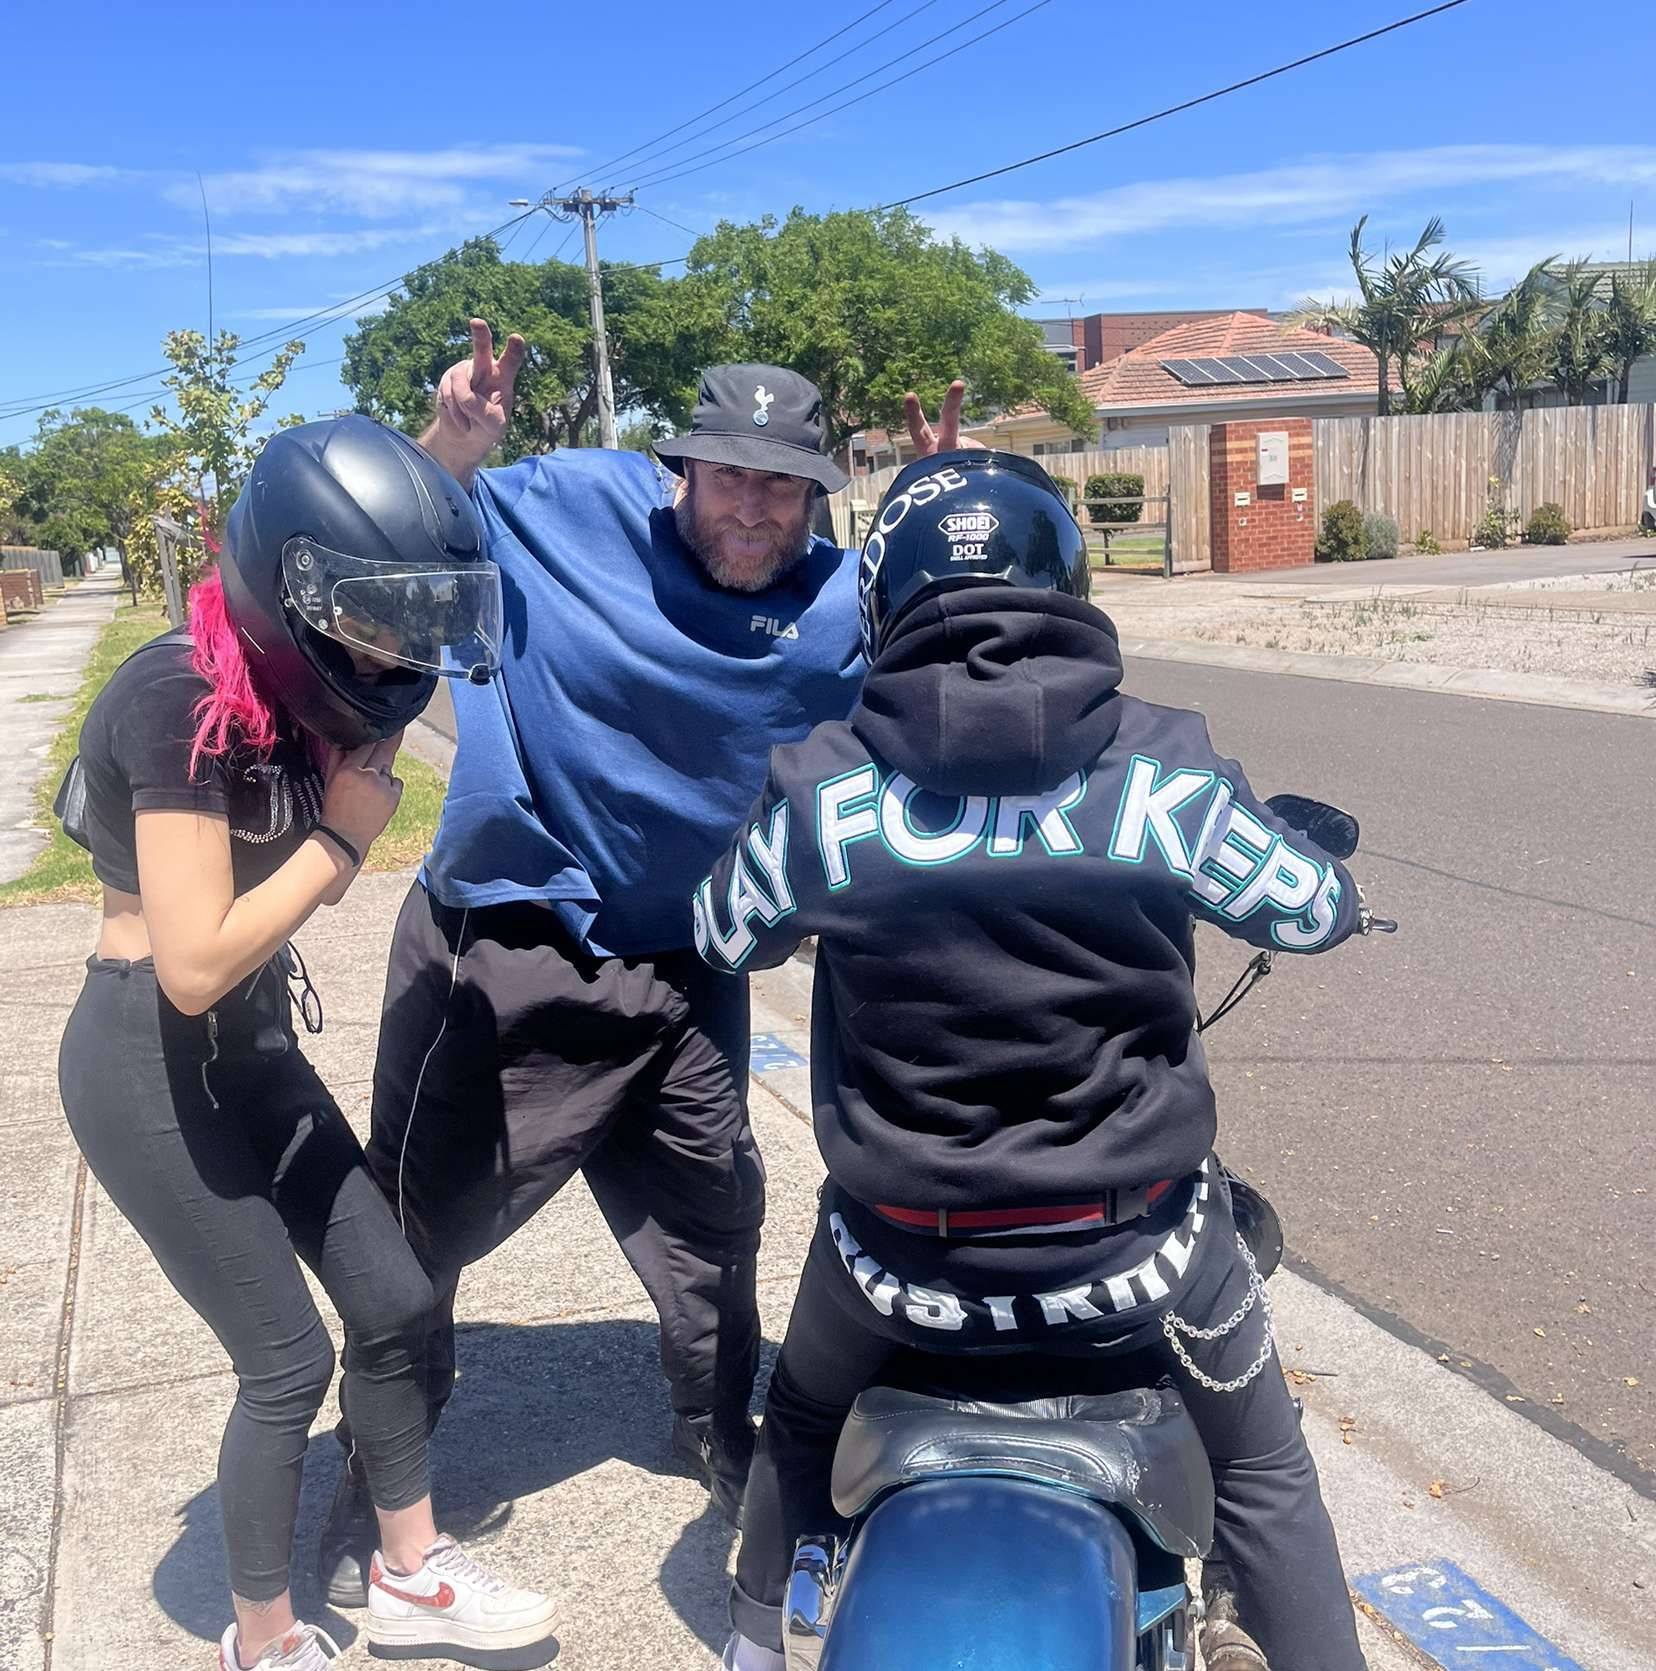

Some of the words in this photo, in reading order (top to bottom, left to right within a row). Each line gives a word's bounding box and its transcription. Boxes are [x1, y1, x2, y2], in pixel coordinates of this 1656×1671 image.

[947, 516, 989, 531] SHOEI
[948, 534, 990, 542] RF-1000
[953, 543, 985, 556] DOT
[750, 615, 799, 640] FILA
[816, 762, 1088, 893] FOR
